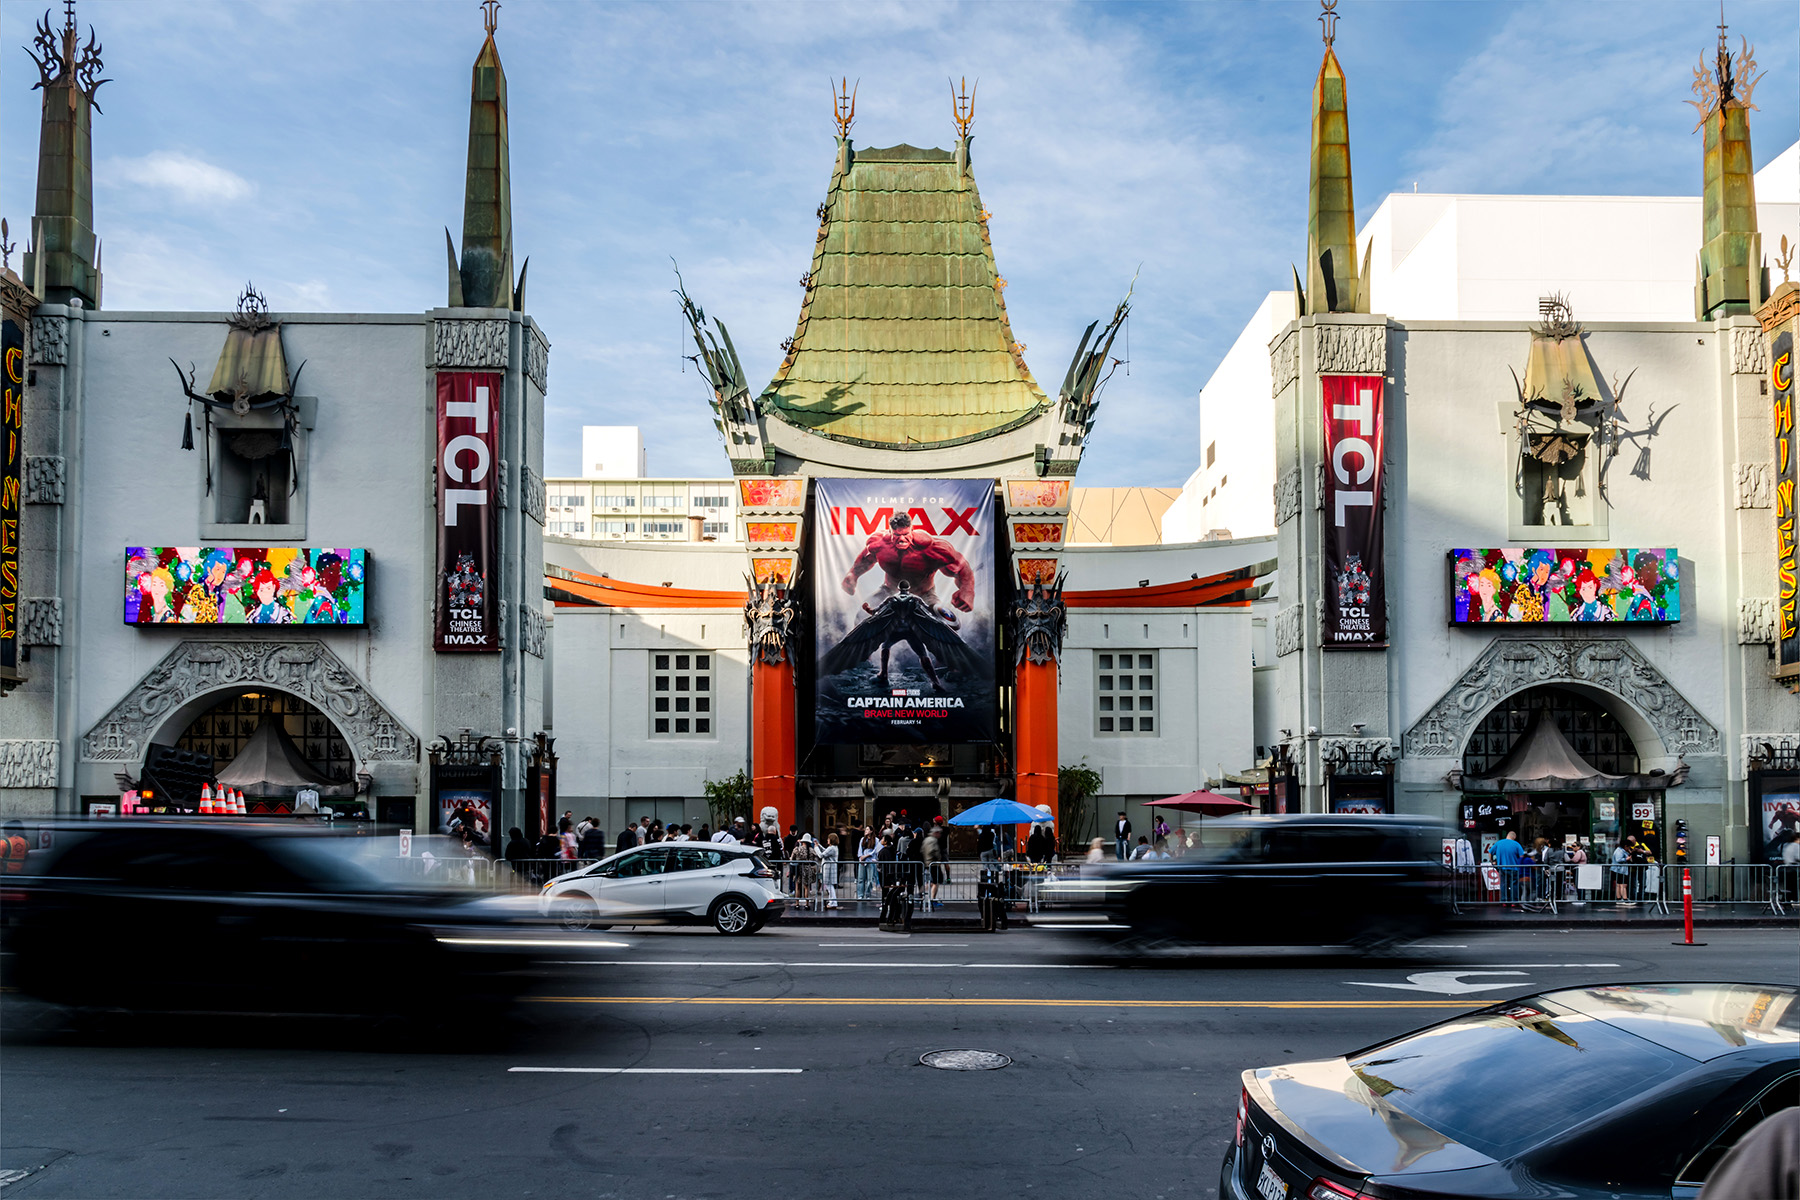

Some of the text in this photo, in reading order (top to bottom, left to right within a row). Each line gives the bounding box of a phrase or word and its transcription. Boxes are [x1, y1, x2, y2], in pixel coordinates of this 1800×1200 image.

[444, 386, 490, 526] TCL
[1333, 389, 1375, 527] TCL
[0, 346, 22, 639] CHINESE
[1772, 352, 1797, 640] CHINESE
[830, 507, 980, 536] IMAX
[449, 609, 482, 619] TCL
[1339, 607, 1370, 617] TCL
[444, 635, 487, 644] IMAX
[1334, 632, 1375, 641] IMAX
[847, 697, 964, 708] CAPTAIN AMERICA
[864, 710, 948, 718] BRAVE NEW WORLD
[442, 799, 491, 809] IMAX
